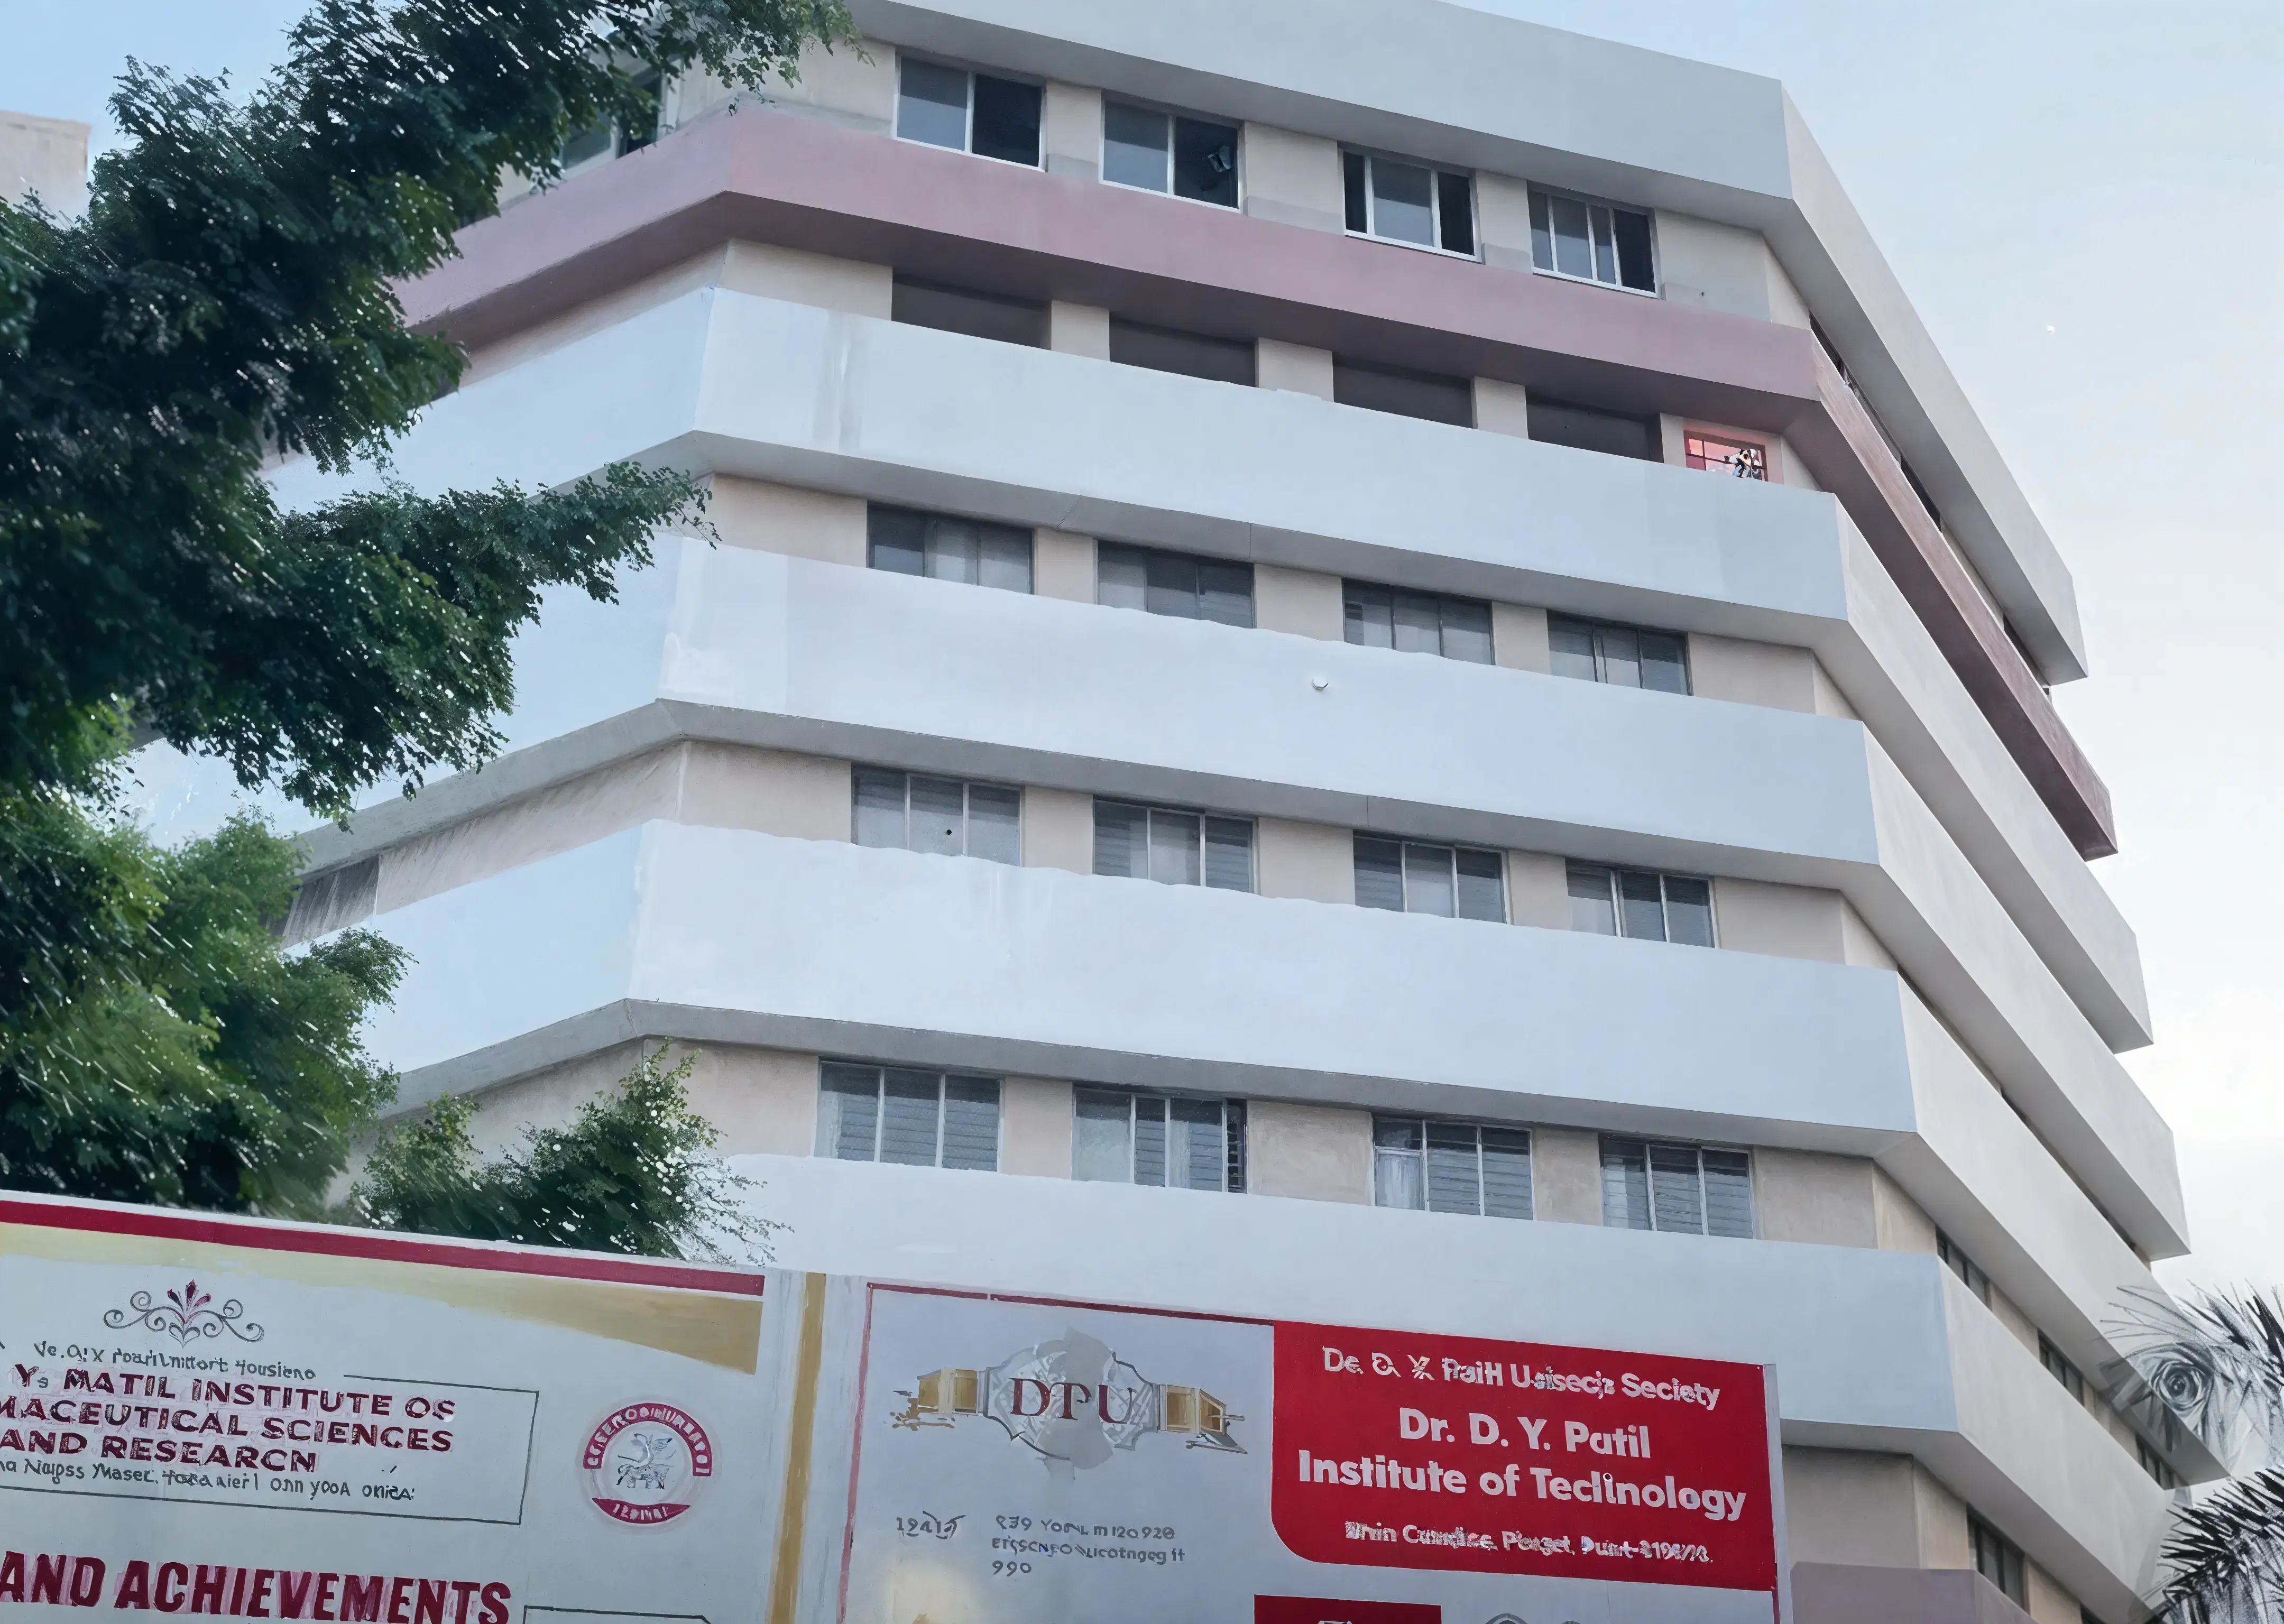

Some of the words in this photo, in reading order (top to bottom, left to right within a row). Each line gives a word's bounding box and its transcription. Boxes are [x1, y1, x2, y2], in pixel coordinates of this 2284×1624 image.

[192, 1378, 393, 1417] INSTITUTE
[0, 1428, 88, 1455] AND
[260, 1417, 454, 1452] SCIENCES
[1399, 1407, 1456, 1443] Dr.
[1469, 1412, 1509, 1447] D.
[1516, 1416, 1552, 1451] Y.
[1564, 1420, 1652, 1459] Patil
[1298, 1449, 1467, 1493] Institute
[1479, 1463, 1520, 1497] of
[0, 1551, 106, 1607] AND
[114, 1560, 511, 1624] ACHIEVEMENTS
